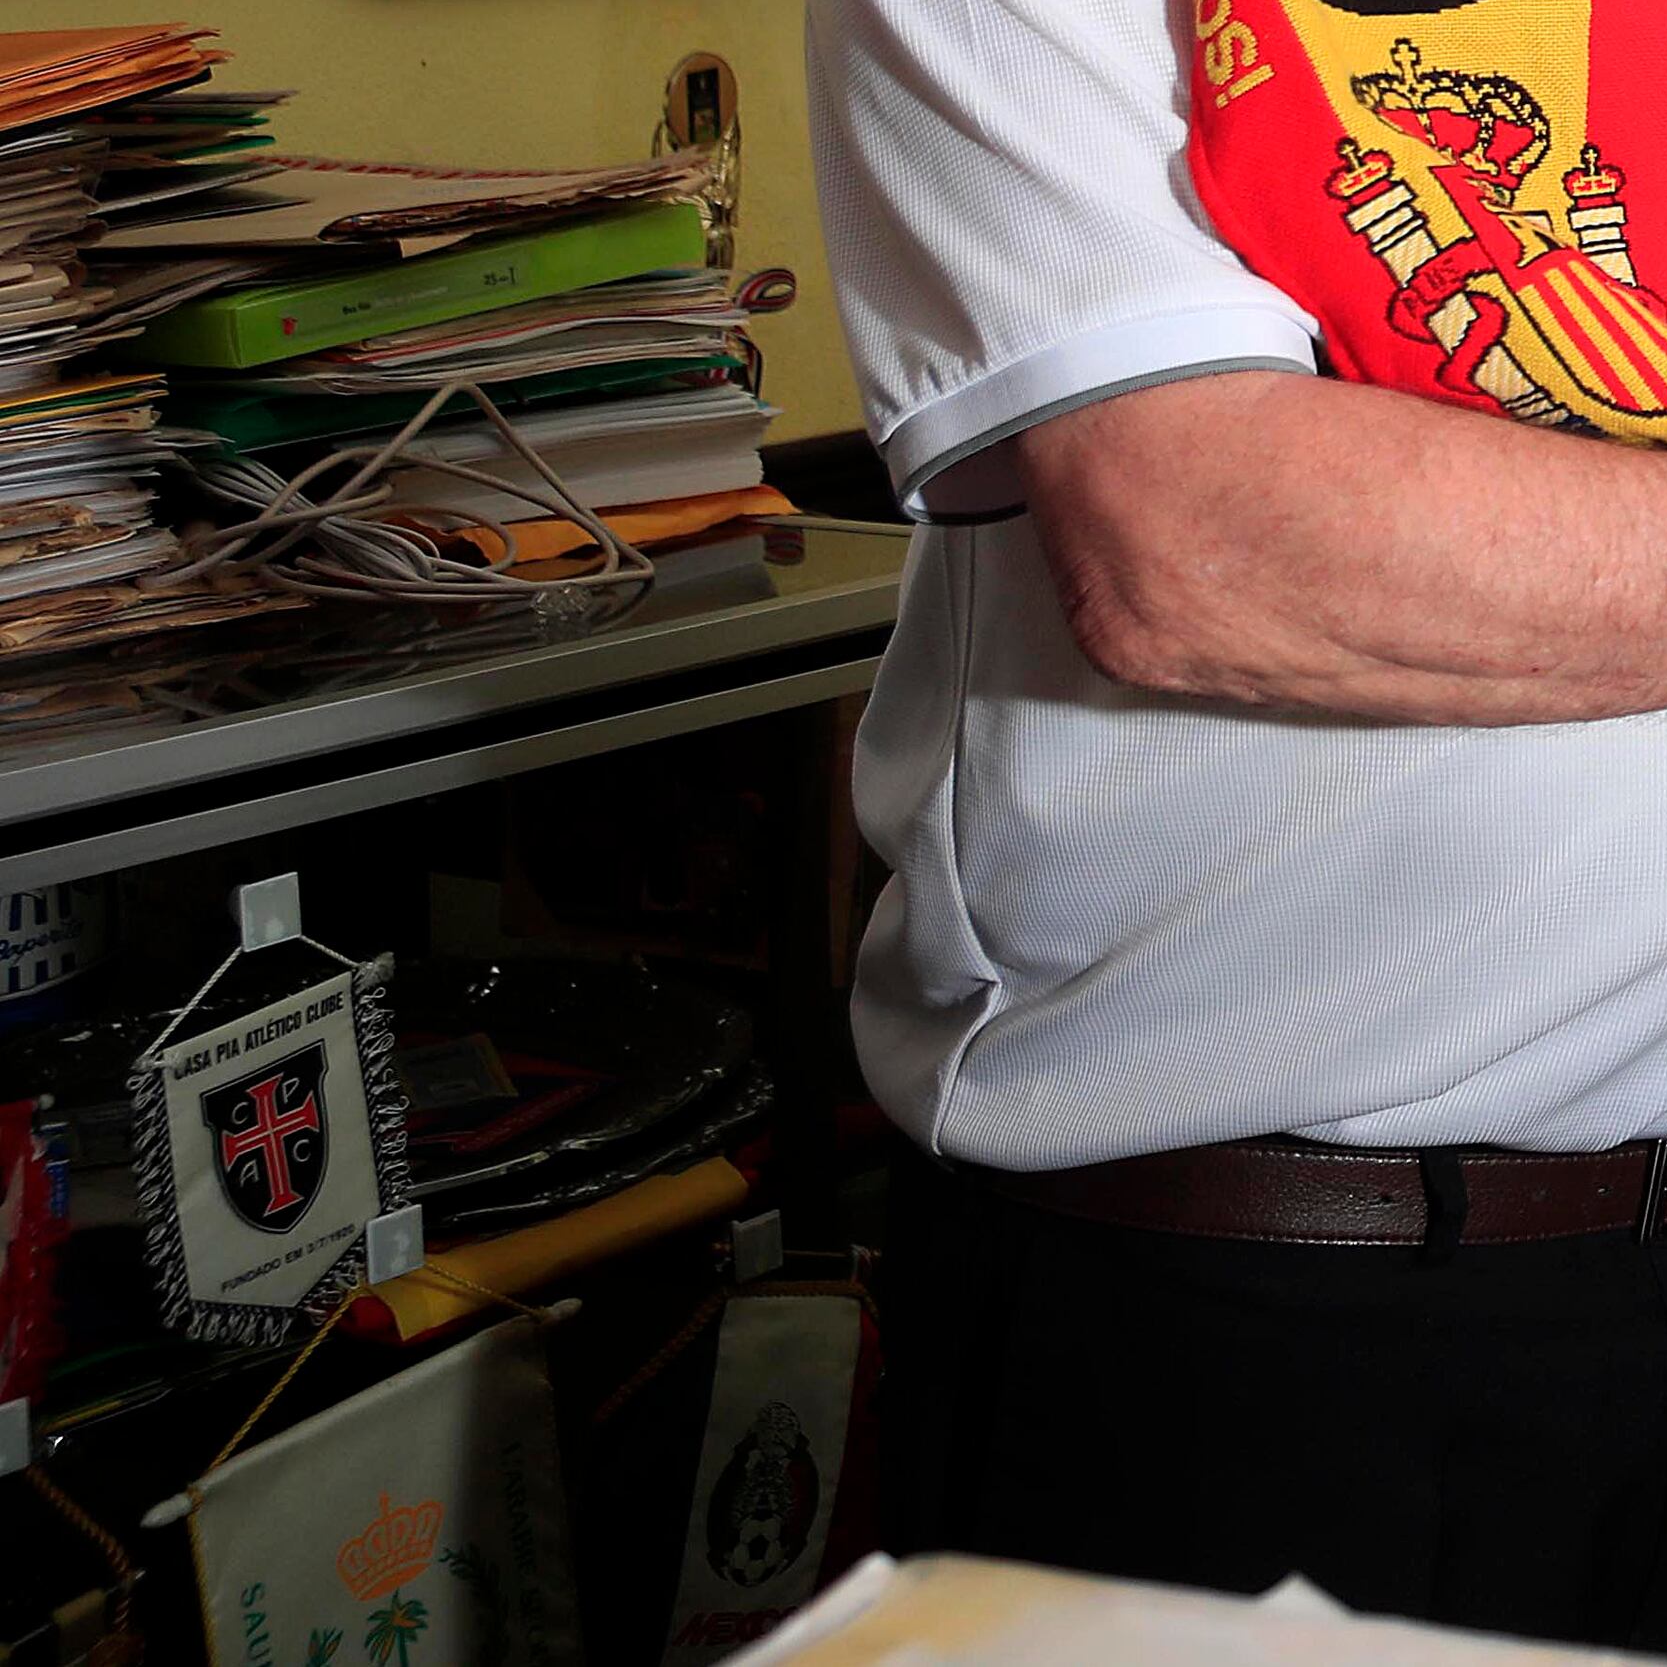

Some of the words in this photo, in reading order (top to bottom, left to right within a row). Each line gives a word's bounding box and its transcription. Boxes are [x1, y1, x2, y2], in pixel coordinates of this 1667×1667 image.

[216, 1039, 240, 1065] PIA
[244, 1011, 302, 1052] ATLÉTICO
[306, 991, 344, 1024] CLUBE
[230, 1101, 248, 1125] C
[280, 1077, 301, 1104] P
[239, 1158, 260, 1189] A
[292, 1138, 312, 1164] C
